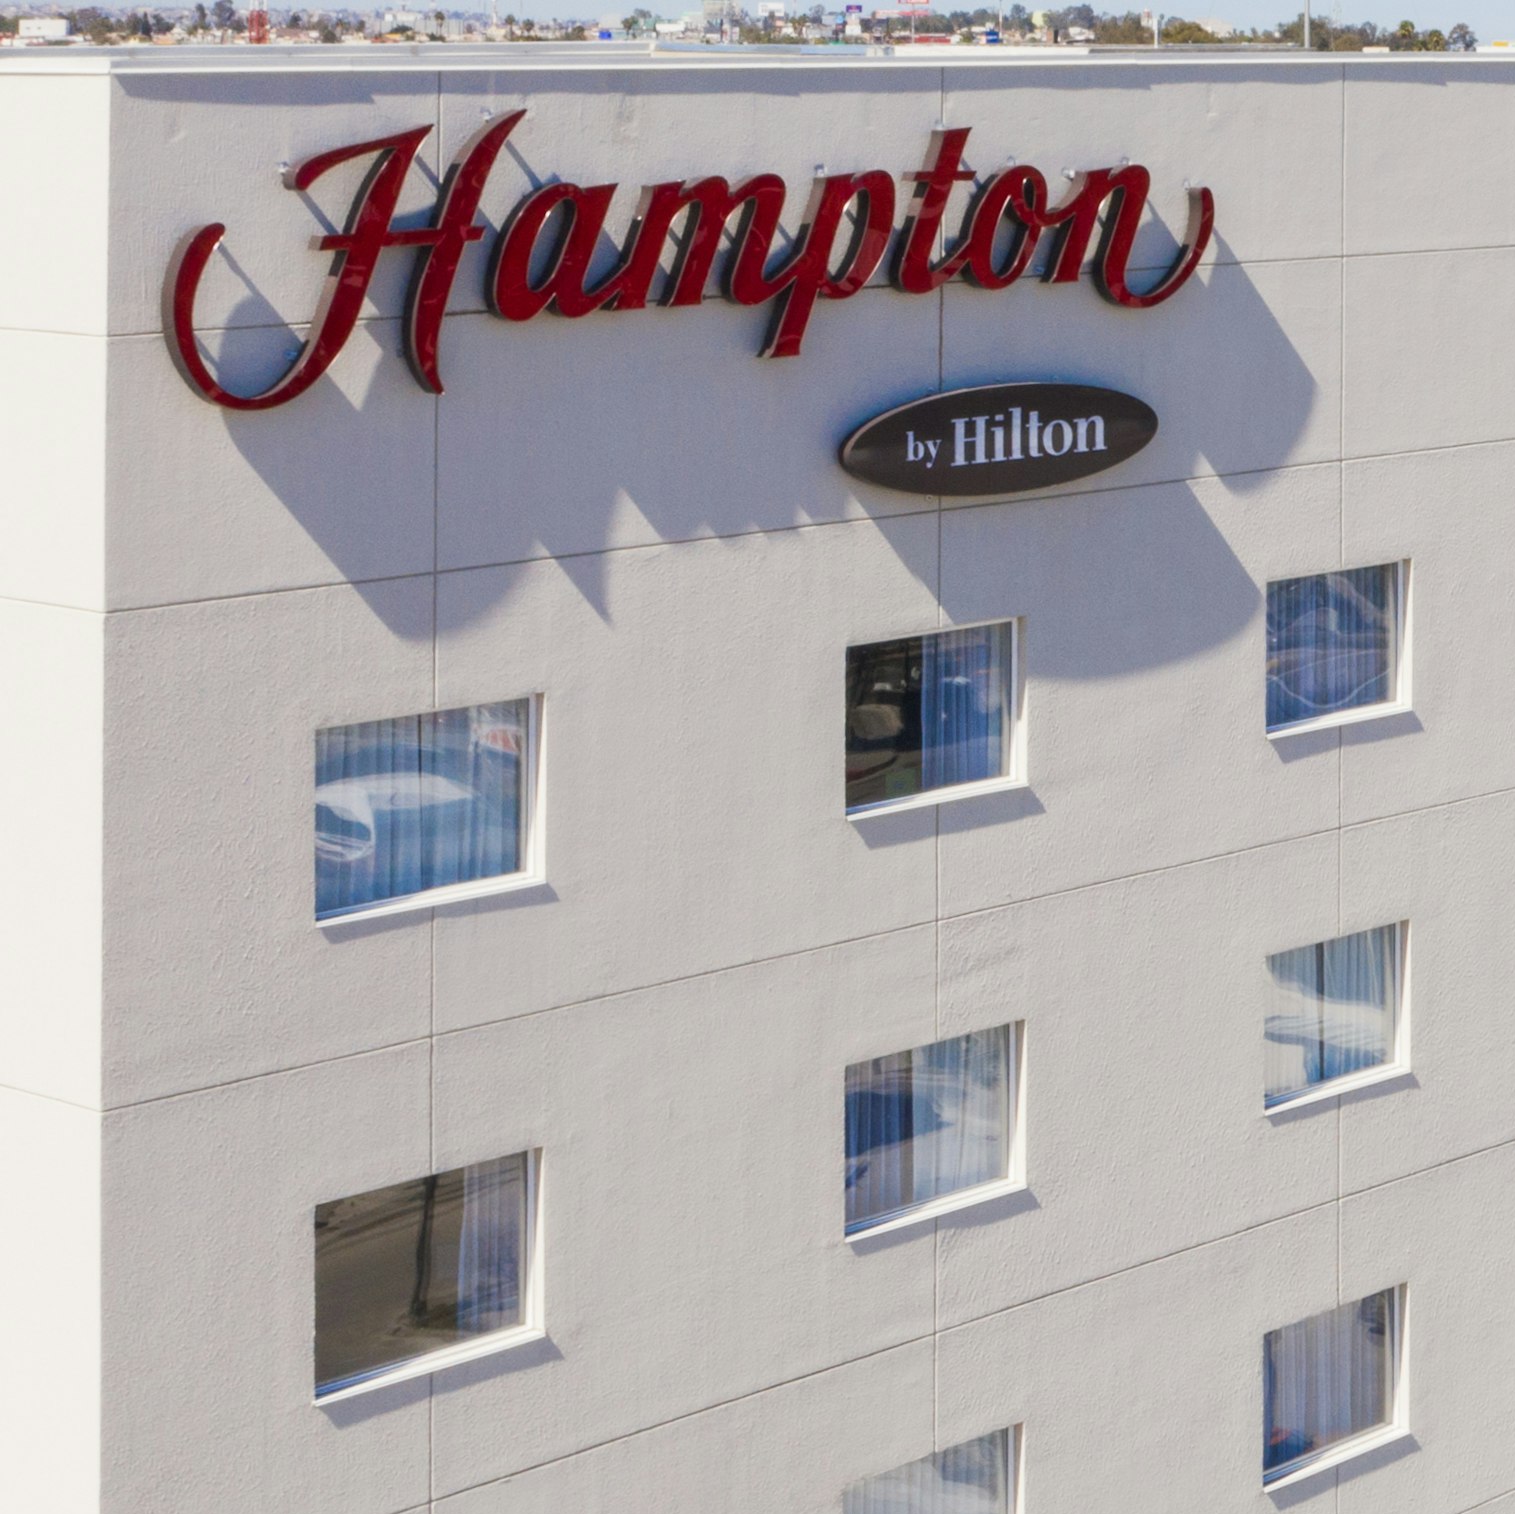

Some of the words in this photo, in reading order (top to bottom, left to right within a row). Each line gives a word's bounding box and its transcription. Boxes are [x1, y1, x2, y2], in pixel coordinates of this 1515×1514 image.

[160, 108, 1214, 411] Hampton
[905, 430, 941, 468] by
[951, 407, 1108, 466] Hilton
